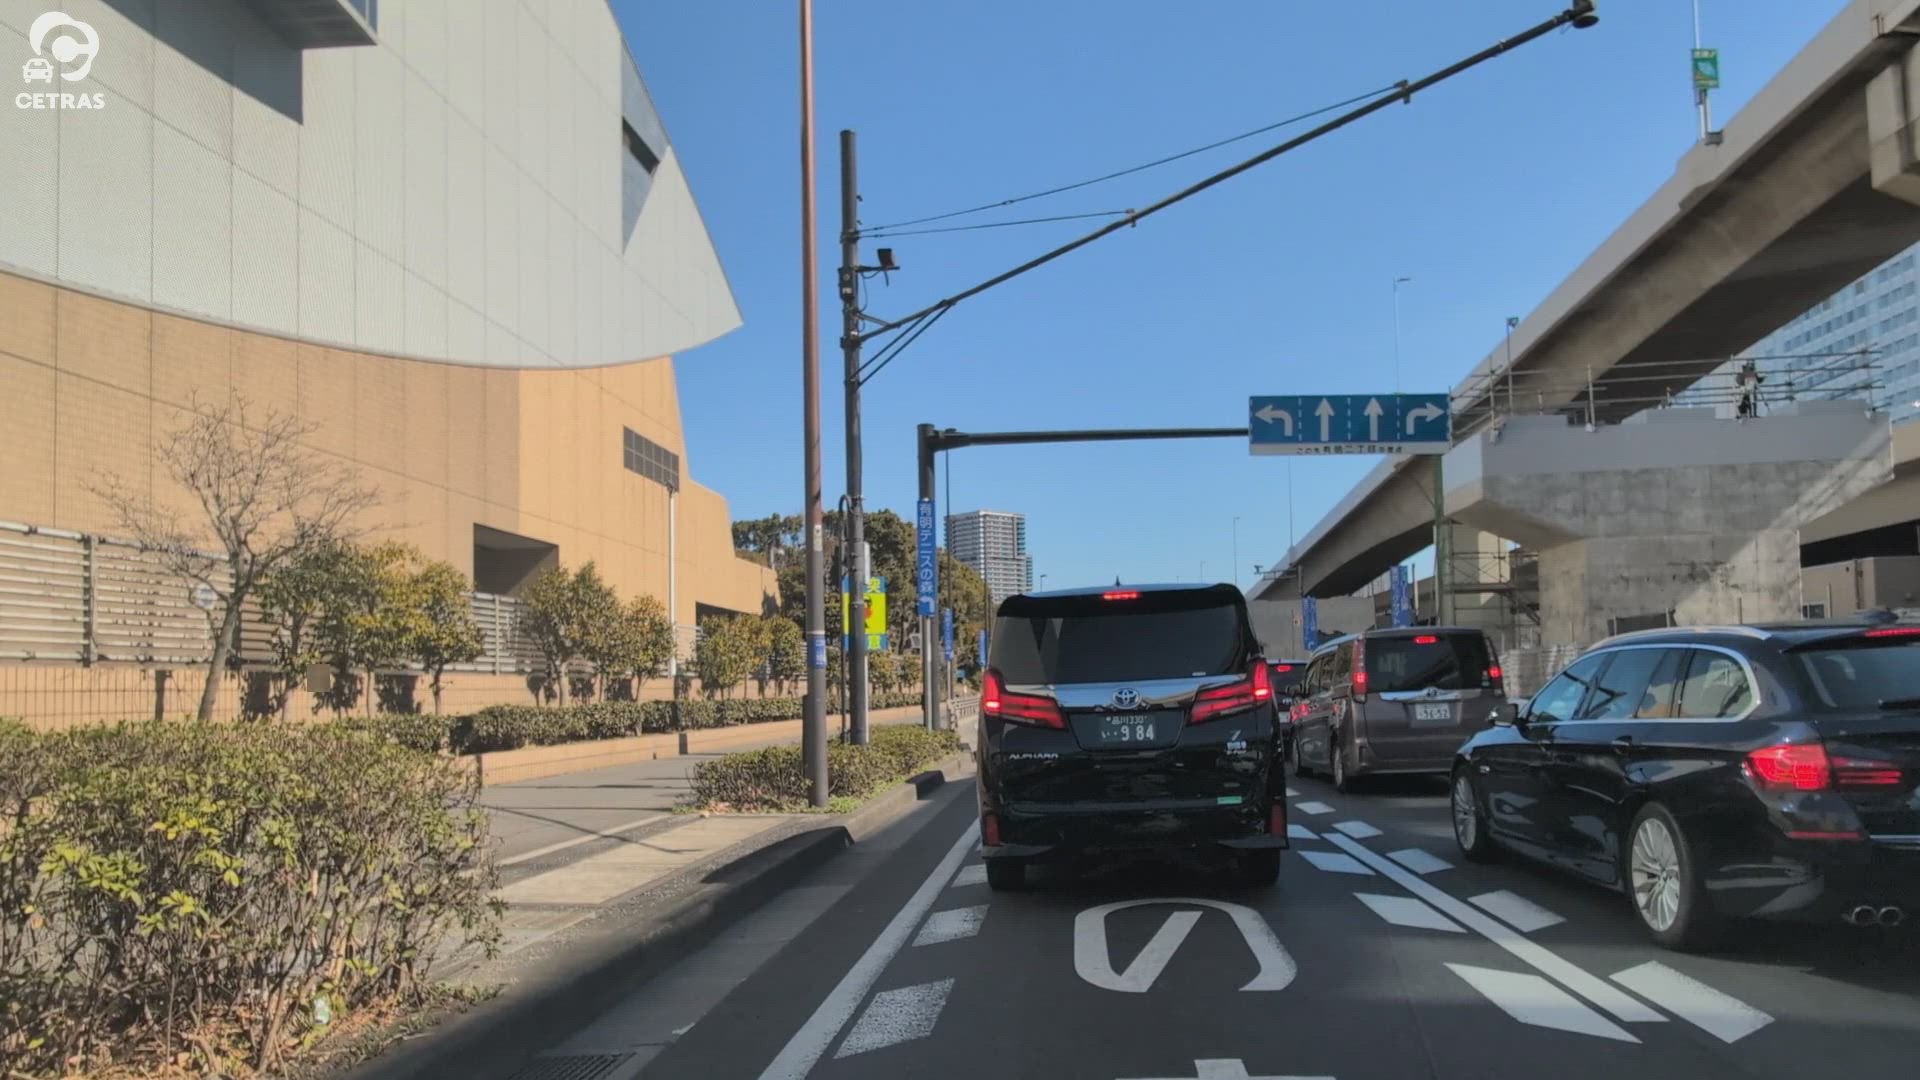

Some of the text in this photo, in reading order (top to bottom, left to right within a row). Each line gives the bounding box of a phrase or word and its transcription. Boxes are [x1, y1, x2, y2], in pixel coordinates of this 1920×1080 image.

[920, 503, 932, 593] 有明テニスの森
